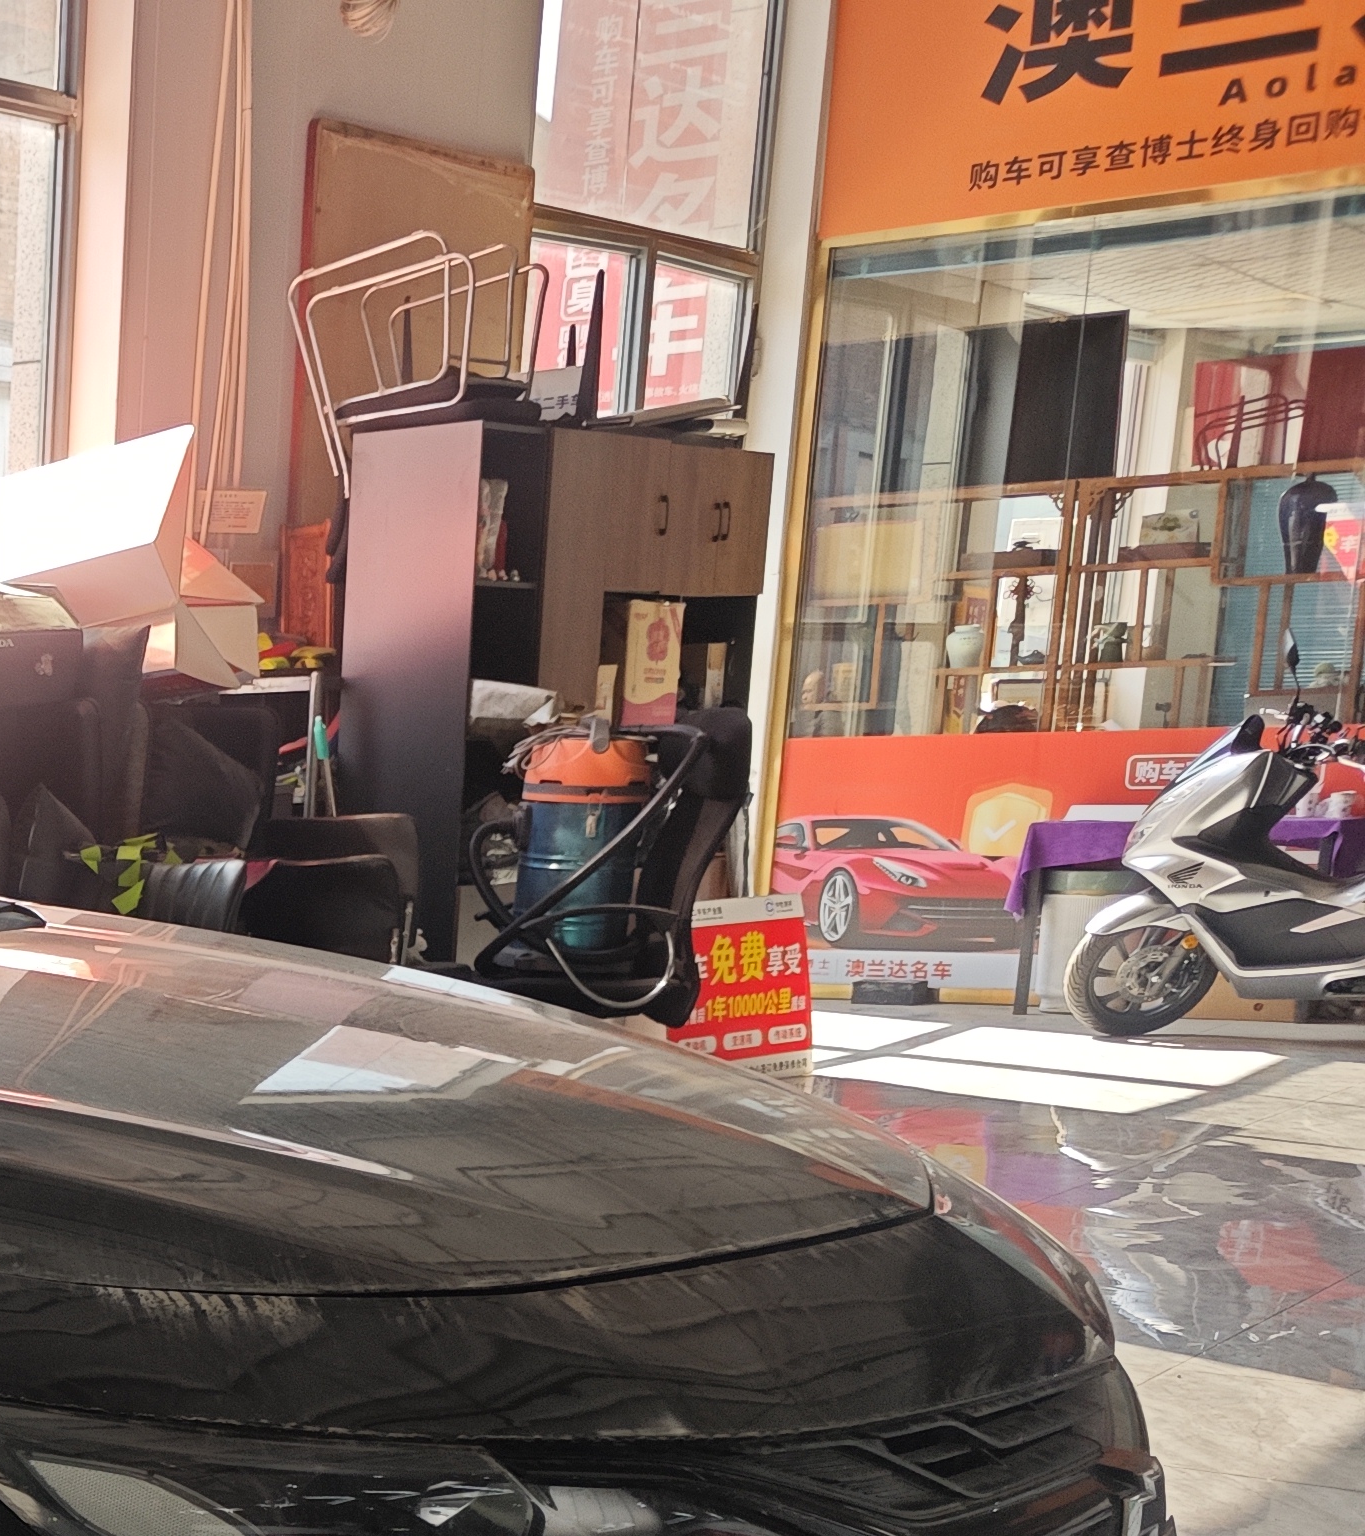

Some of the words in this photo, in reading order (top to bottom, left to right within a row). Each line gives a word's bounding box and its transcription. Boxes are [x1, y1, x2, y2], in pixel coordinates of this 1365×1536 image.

[980, 0, 1365, 105] 澳兰
[1219, 62, 1355, 106] Aola
[969, 106, 1365, 192] 购车可享查博士终身回购
[845, 957, 953, 981] 澳兰达名车
